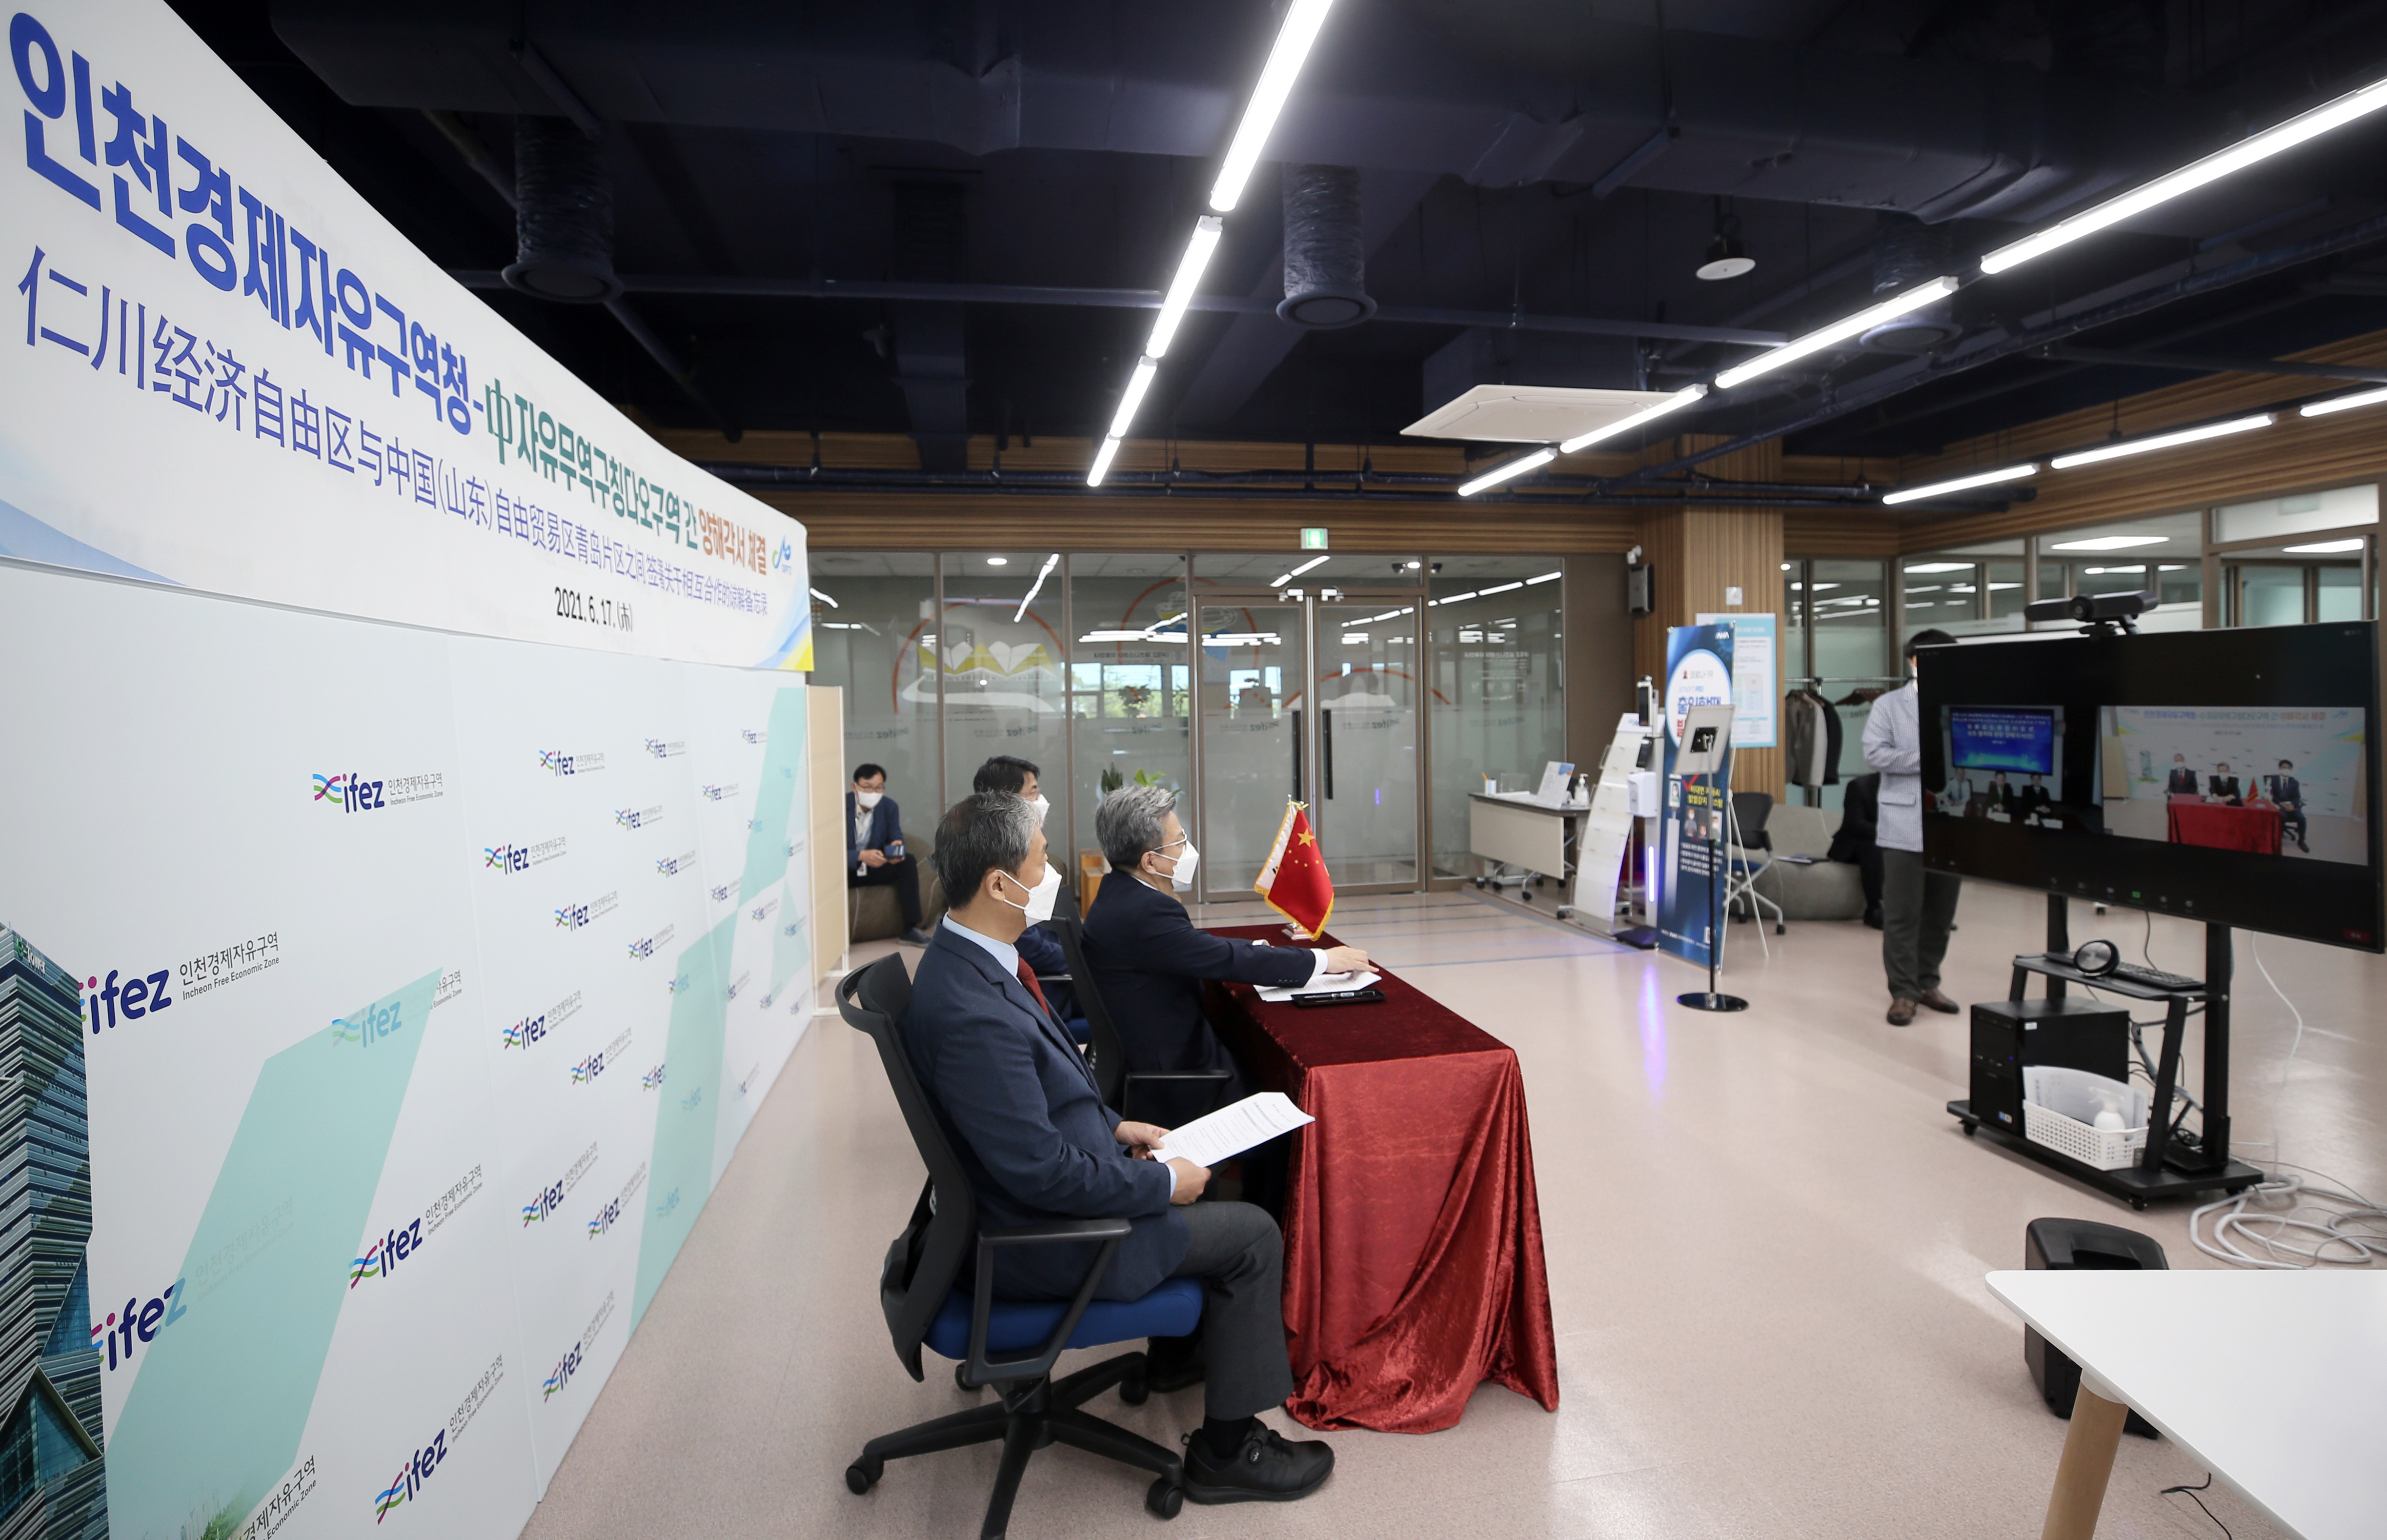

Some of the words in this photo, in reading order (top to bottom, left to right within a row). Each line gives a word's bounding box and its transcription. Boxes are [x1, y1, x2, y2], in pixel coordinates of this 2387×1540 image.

[683, 500, 698, 550] 간
[699, 508, 744, 568] 양해각서
[748, 529, 766, 576] 체결
[388, 772, 443, 795] 인천경제자유구역
[553, 750, 575, 776] ifez
[343, 772, 384, 813] ifez
[625, 808, 641, 831] ifez
[503, 844, 529, 875] ifez
[568, 903, 589, 932] ifez
[180, 932, 279, 986] 인천경제자유구역
[638, 938, 653, 962] ifez
[182, 983, 212, 1000] Incheon
[214, 976, 229, 988] Free
[231, 963, 263, 981] Economic
[264, 957, 280, 969] Zone
[88, 969, 173, 1034] ifez
[361, 1001, 402, 1048] ifez
[521, 1015, 546, 1050] ifez
[584, 1052, 605, 1085] ifez
[425, 1163, 483, 1225] 인천경제자유구역
[539, 1179, 564, 1222] ifez
[600, 1197, 620, 1235] ifez
[379, 1217, 423, 1278] ifez
[106, 1277, 187, 1372] ifez
[558, 1340, 582, 1391] ifez
[449, 1353, 503, 1434] 인천경제자유구역
[405, 1428, 447, 1502] ifez
[267, 1499, 300, 1540] Economic
[301, 1479, 317, 1502] Zone
